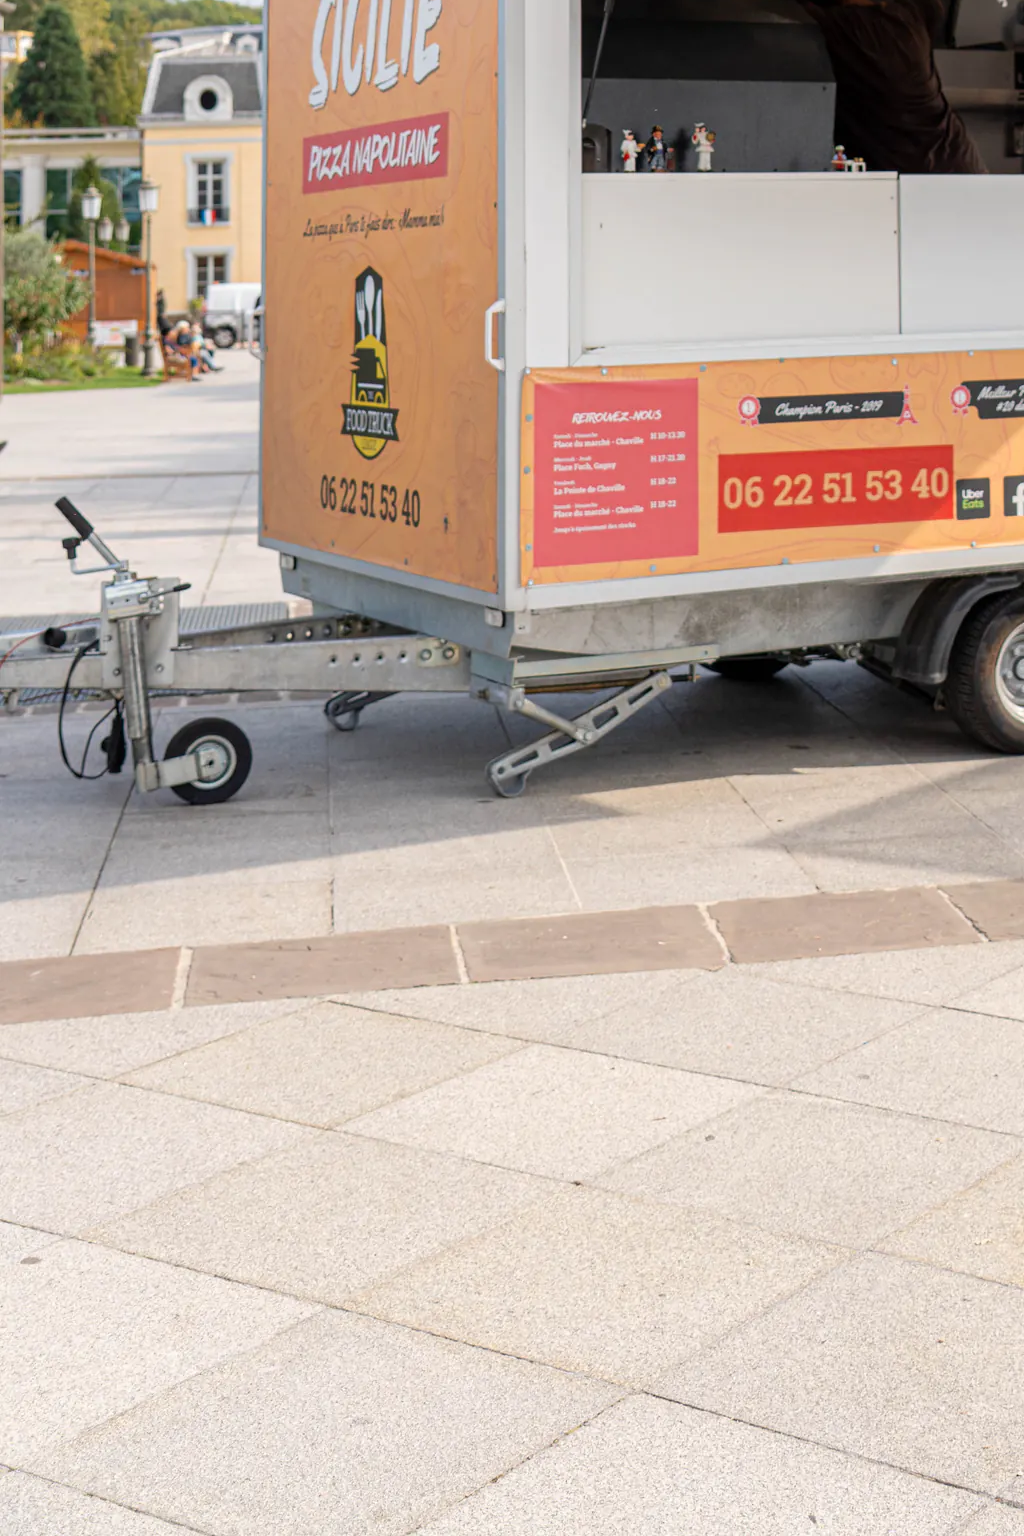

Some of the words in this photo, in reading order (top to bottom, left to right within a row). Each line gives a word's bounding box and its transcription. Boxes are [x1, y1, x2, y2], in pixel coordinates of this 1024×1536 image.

[308, 140, 351, 182] PIZZA
[352, 124, 441, 174] NAPOLITAINE
[775, 402, 823, 419] Champion
[825, 400, 852, 414] Paris
[346, 408, 367, 432] FOOD
[368, 410, 394, 436] TRUCK
[723, 477, 764, 509] 06
[773, 474, 813, 506] 22
[822, 472, 856, 503] 51
[865, 469, 902, 501] 53
[911, 467, 949, 499] 40
[961, 489, 984, 499] Uber
[320, 474, 336, 511] 06
[340, 477, 356, 514] 22
[360, 480, 376, 518] 51
[380, 483, 397, 523] 53
[401, 488, 420, 528] 40
[962, 499, 984, 509] Eats
[553, 510, 573, 518] Place
